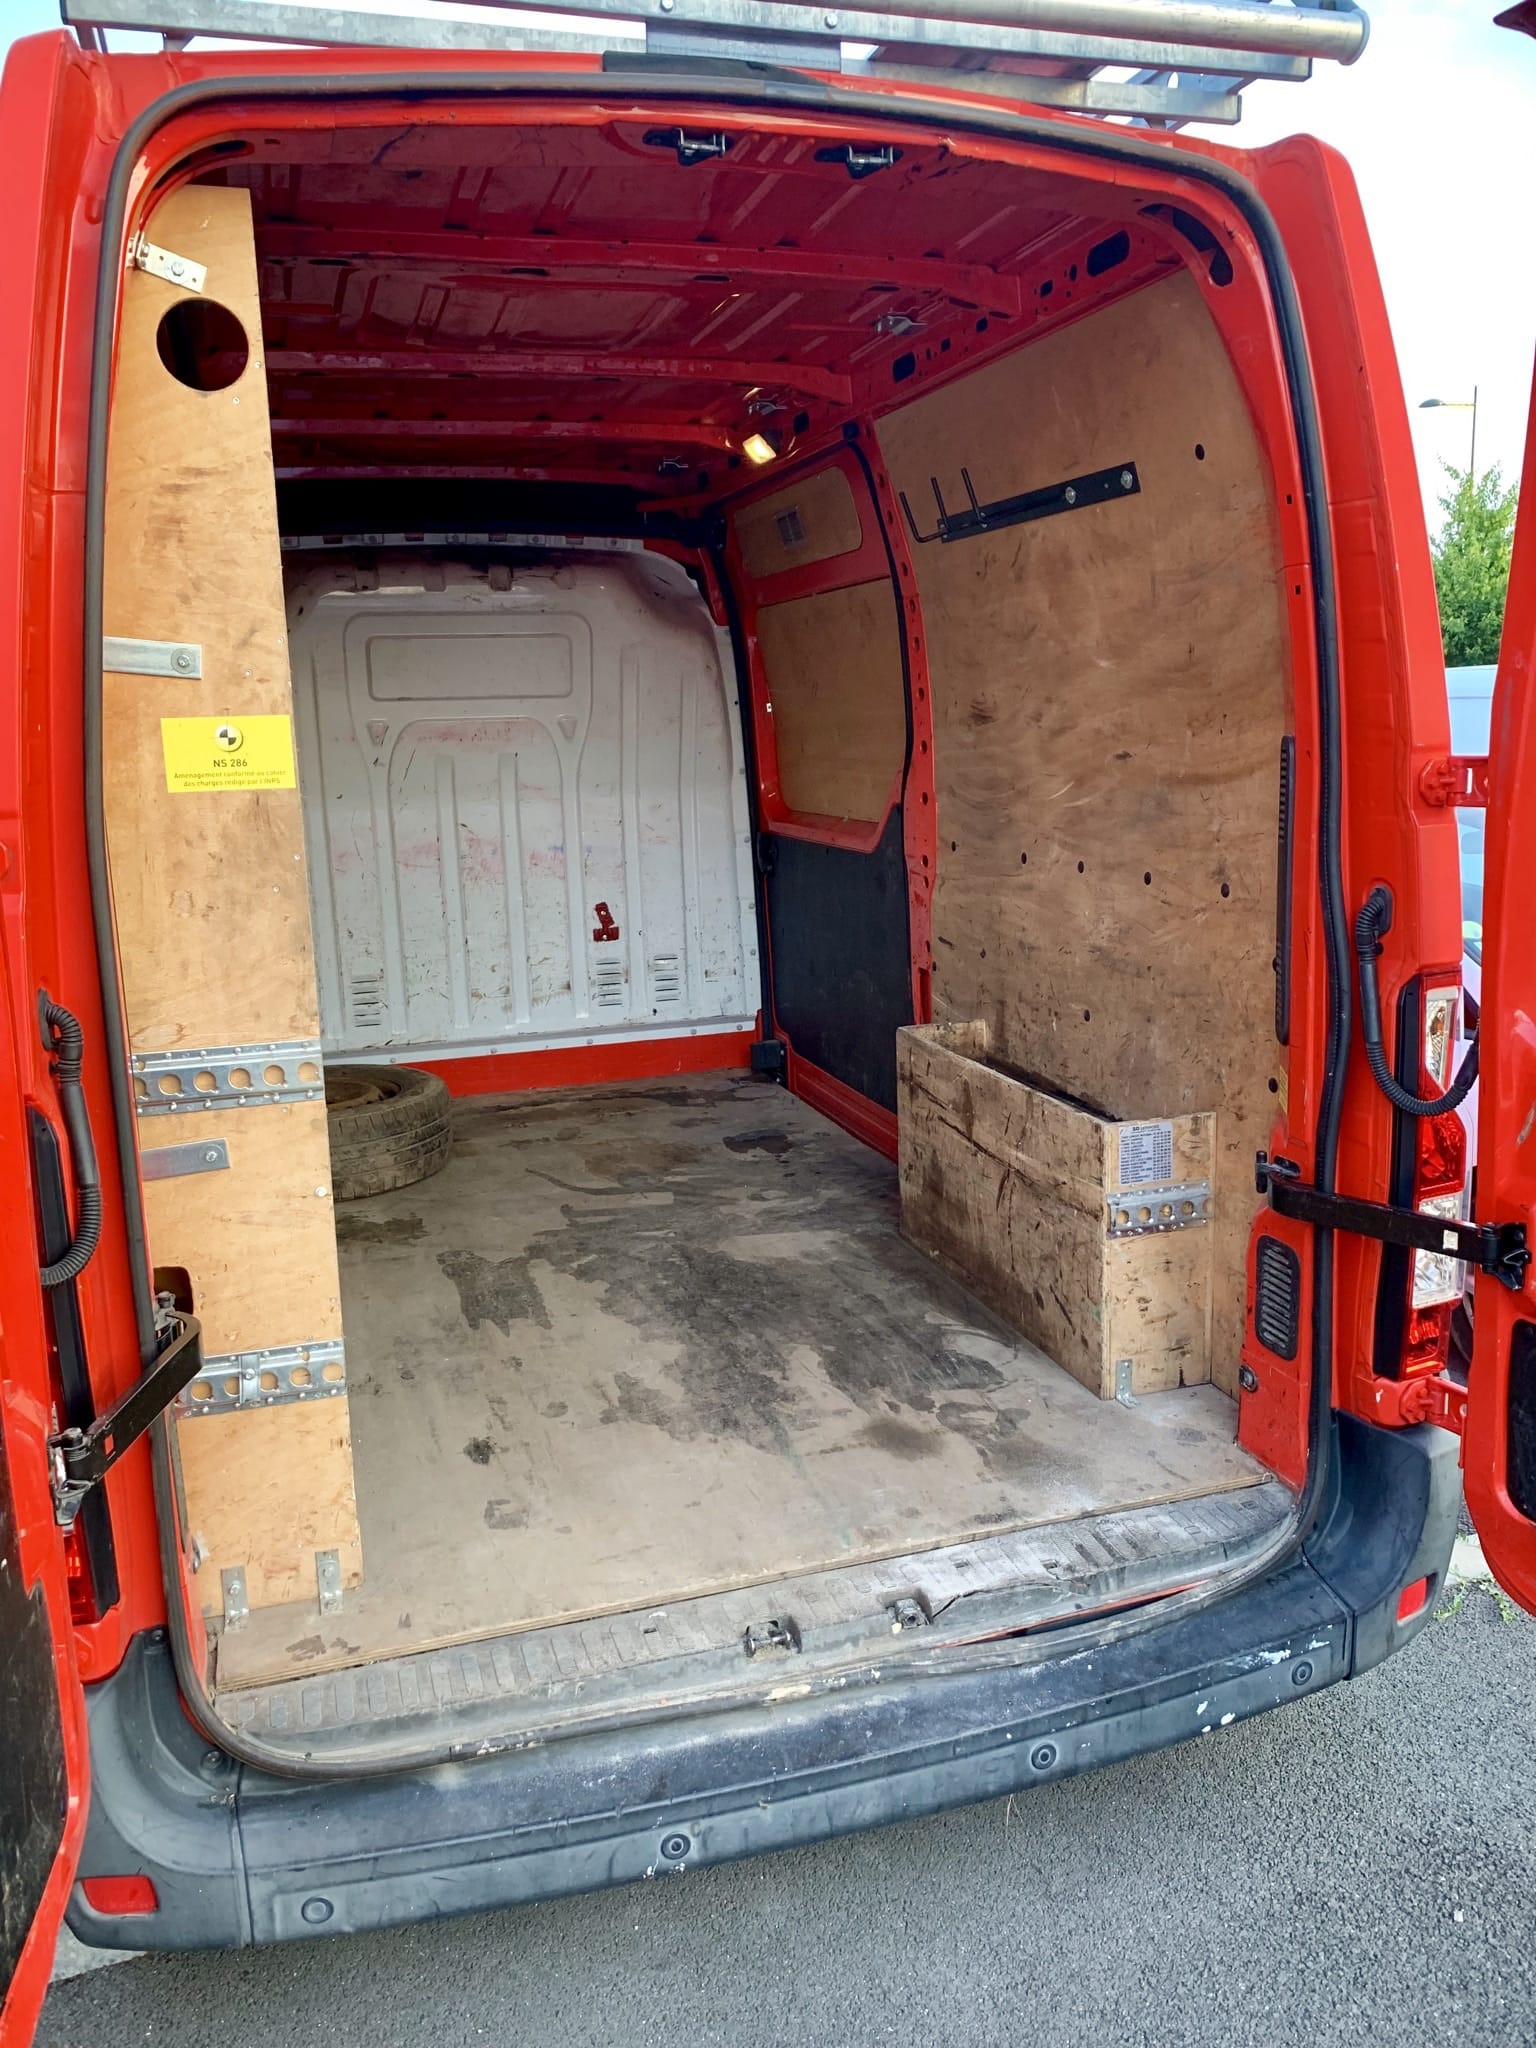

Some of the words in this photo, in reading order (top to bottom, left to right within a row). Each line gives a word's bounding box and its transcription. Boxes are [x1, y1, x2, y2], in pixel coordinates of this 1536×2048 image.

[213, 758, 228, 768] NS
[230, 758, 248, 768] 286
[197, 780, 223, 788] charges
